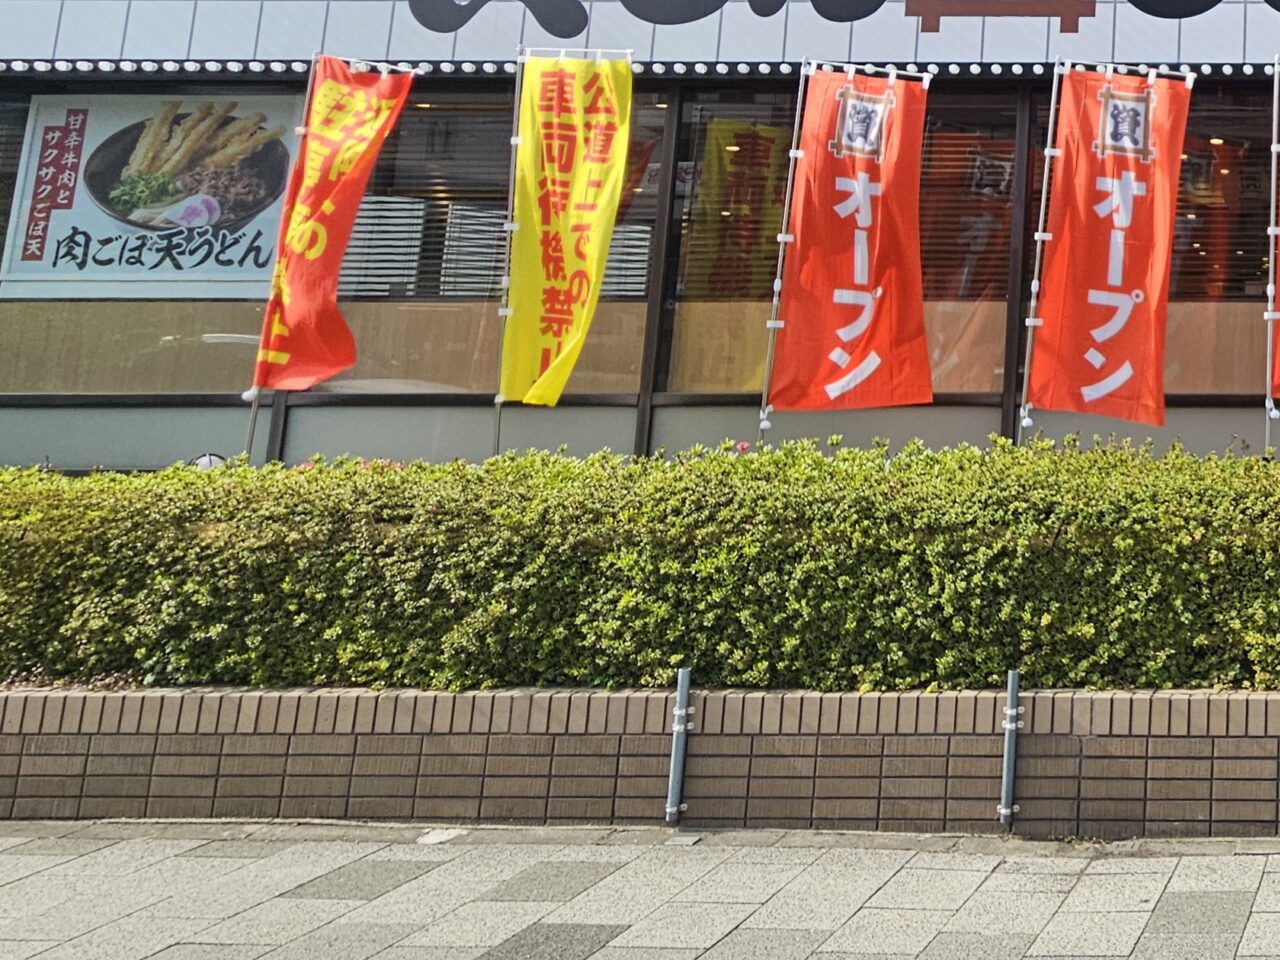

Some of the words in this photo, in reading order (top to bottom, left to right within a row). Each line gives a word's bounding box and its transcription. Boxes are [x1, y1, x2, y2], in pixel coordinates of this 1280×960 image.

[25, 129, 62, 257] サクサクごぼ天
[57, 112, 85, 205] 甘辛牛肉と
[52, 225, 275, 272] 肉ごぼ天うどん
[824, 172, 883, 401] オープン
[1080, 170, 1147, 403] オープン
